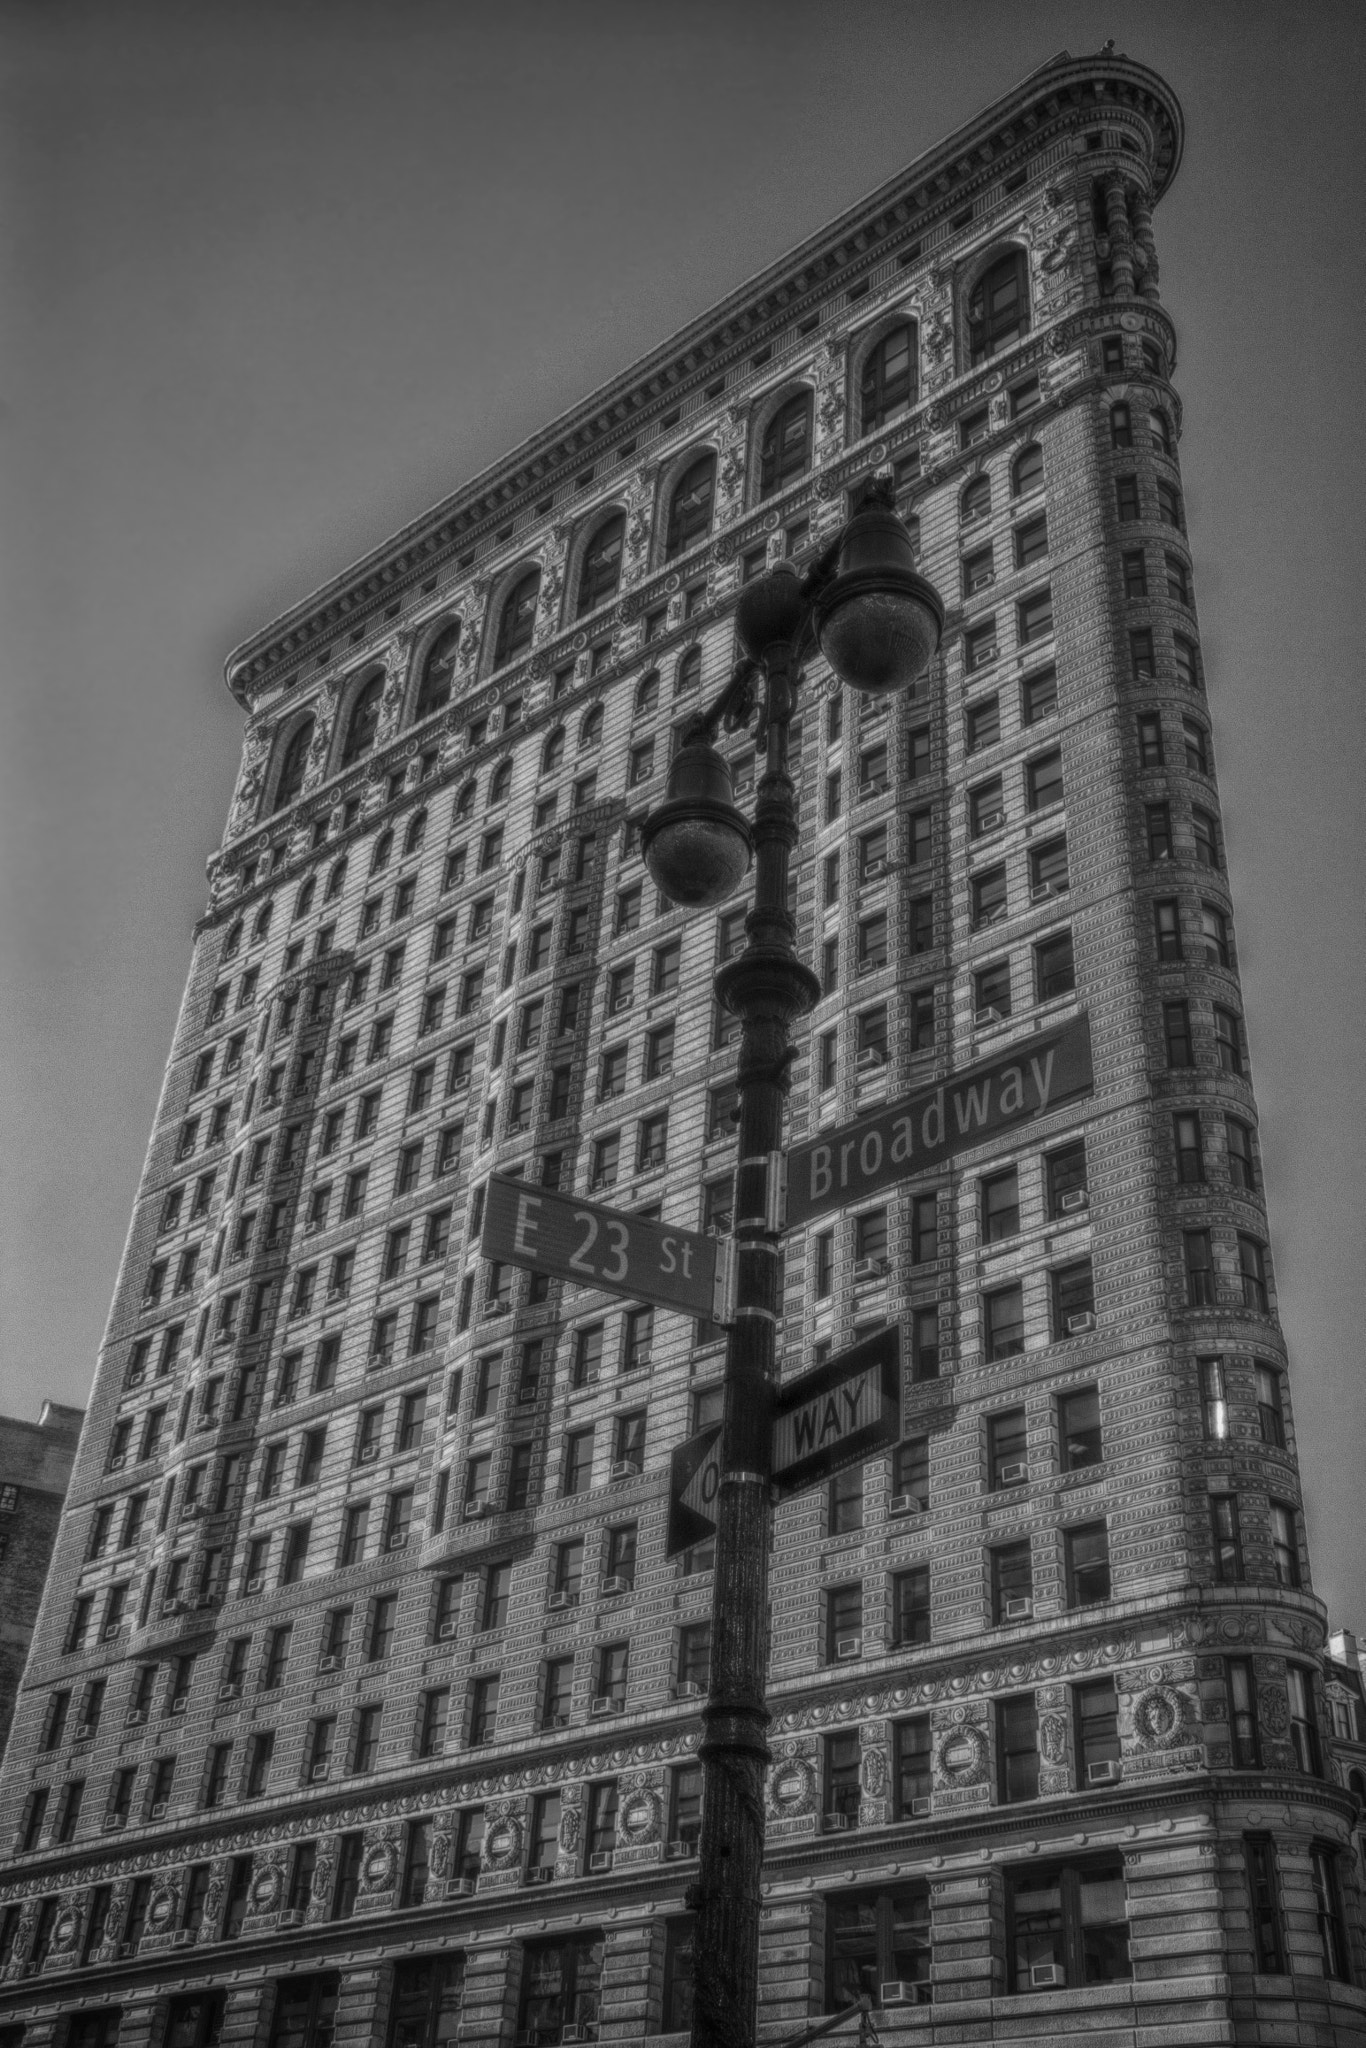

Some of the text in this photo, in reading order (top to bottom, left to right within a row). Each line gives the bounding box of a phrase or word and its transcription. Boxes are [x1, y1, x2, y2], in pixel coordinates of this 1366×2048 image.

[810, 1049, 1055, 1200] Broadway
[513, 1193, 694, 1281] E 23 St
[793, 1379, 866, 1457] WAY
